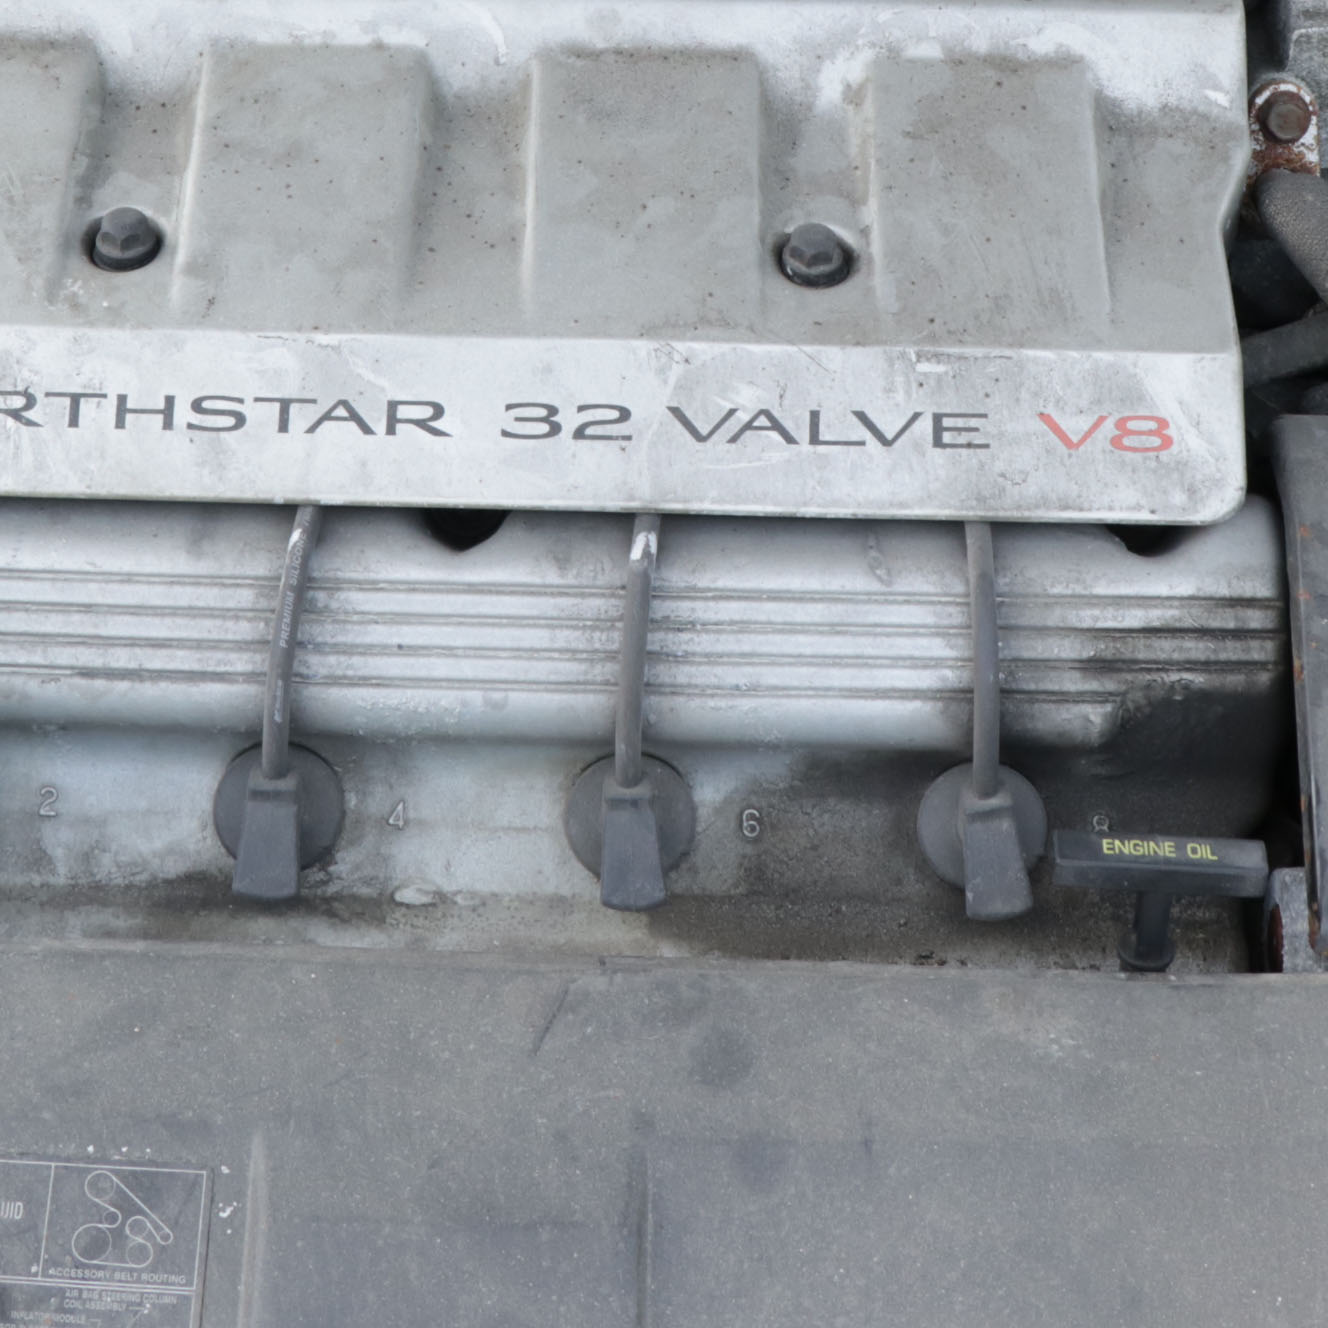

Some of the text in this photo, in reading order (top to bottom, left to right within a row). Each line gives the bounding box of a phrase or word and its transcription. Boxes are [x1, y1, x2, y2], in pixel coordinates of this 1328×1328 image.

[500, 402, 633, 441] 32
[665, 406, 991, 450] VALVE
[1037, 412, 1174, 454] V8
[280, 532, 307, 648] PREMIUM SILICONE
[38, 787, 58, 817] 2
[388, 800, 405, 830] 4
[742, 809, 760, 838] 6
[1102, 838, 1219, 860] ENGINE OIL
[49, 1268, 186, 1284] ACCESSORY BELT ROUTING
